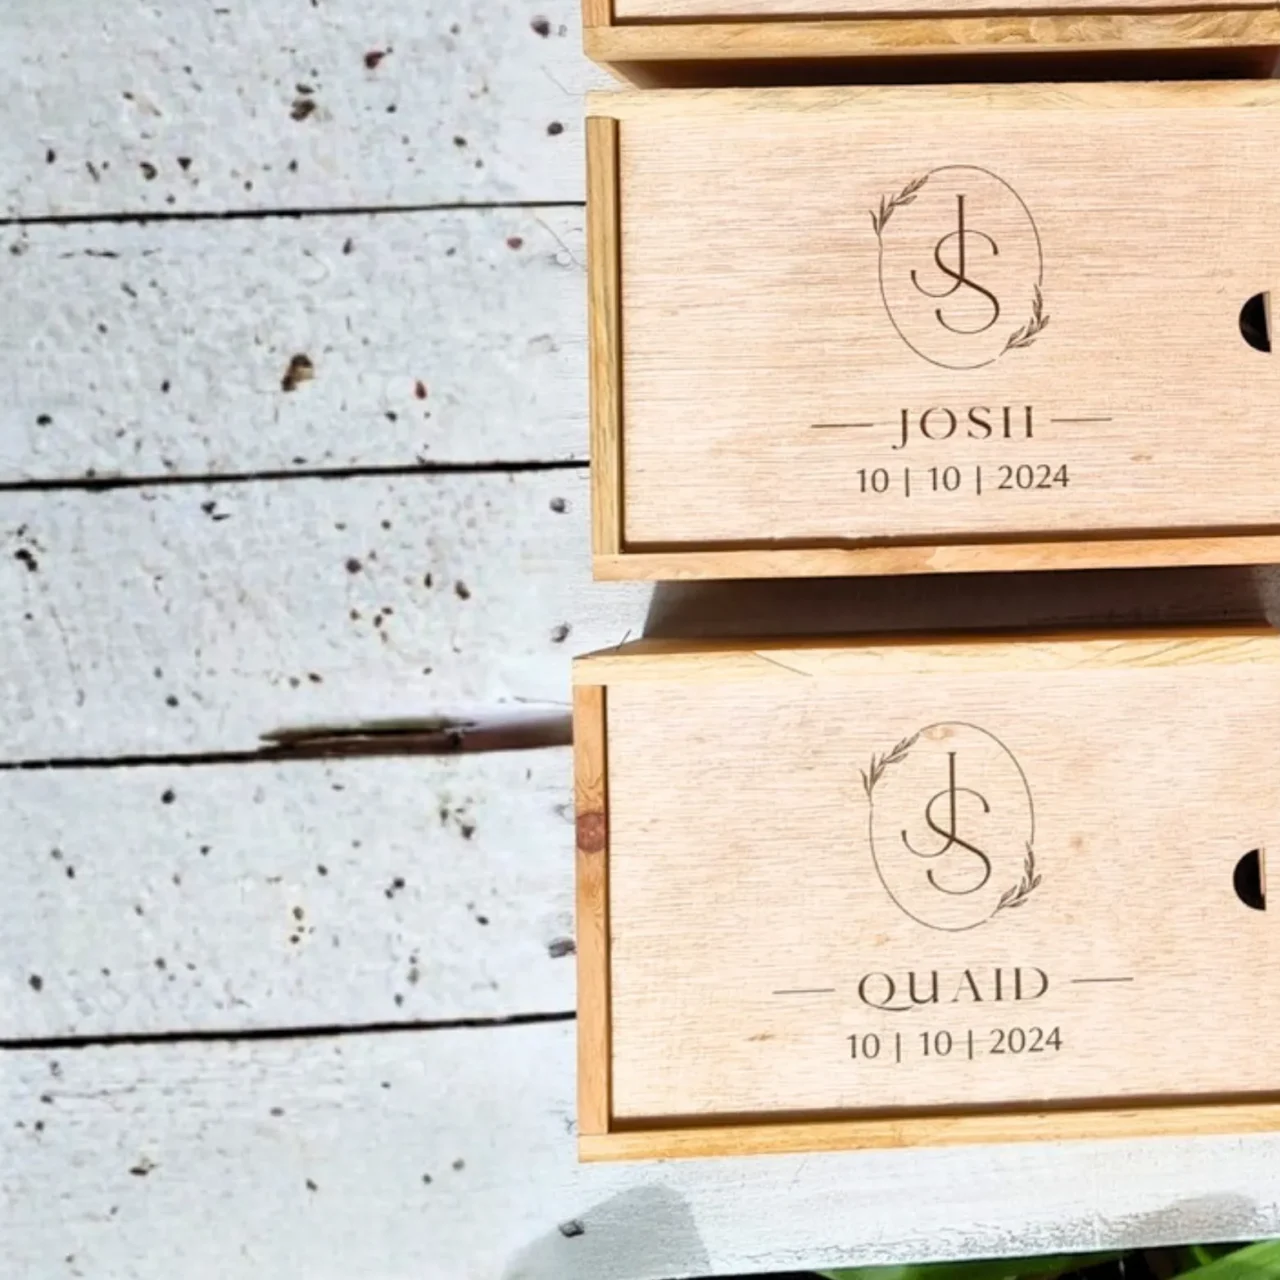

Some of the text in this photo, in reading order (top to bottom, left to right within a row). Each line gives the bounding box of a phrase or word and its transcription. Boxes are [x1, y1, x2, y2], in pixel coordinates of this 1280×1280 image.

[890, 404, 1035, 451] JOSH
[856, 467, 890, 494] 10
[927, 465, 962, 492] 10
[997, 463, 1071, 491] 2024
[857, 966, 1050, 1013] QUAID
[846, 1032, 881, 1060] 10
[919, 1030, 954, 1057] 10
[988, 1026, 1064, 1055] 2024
